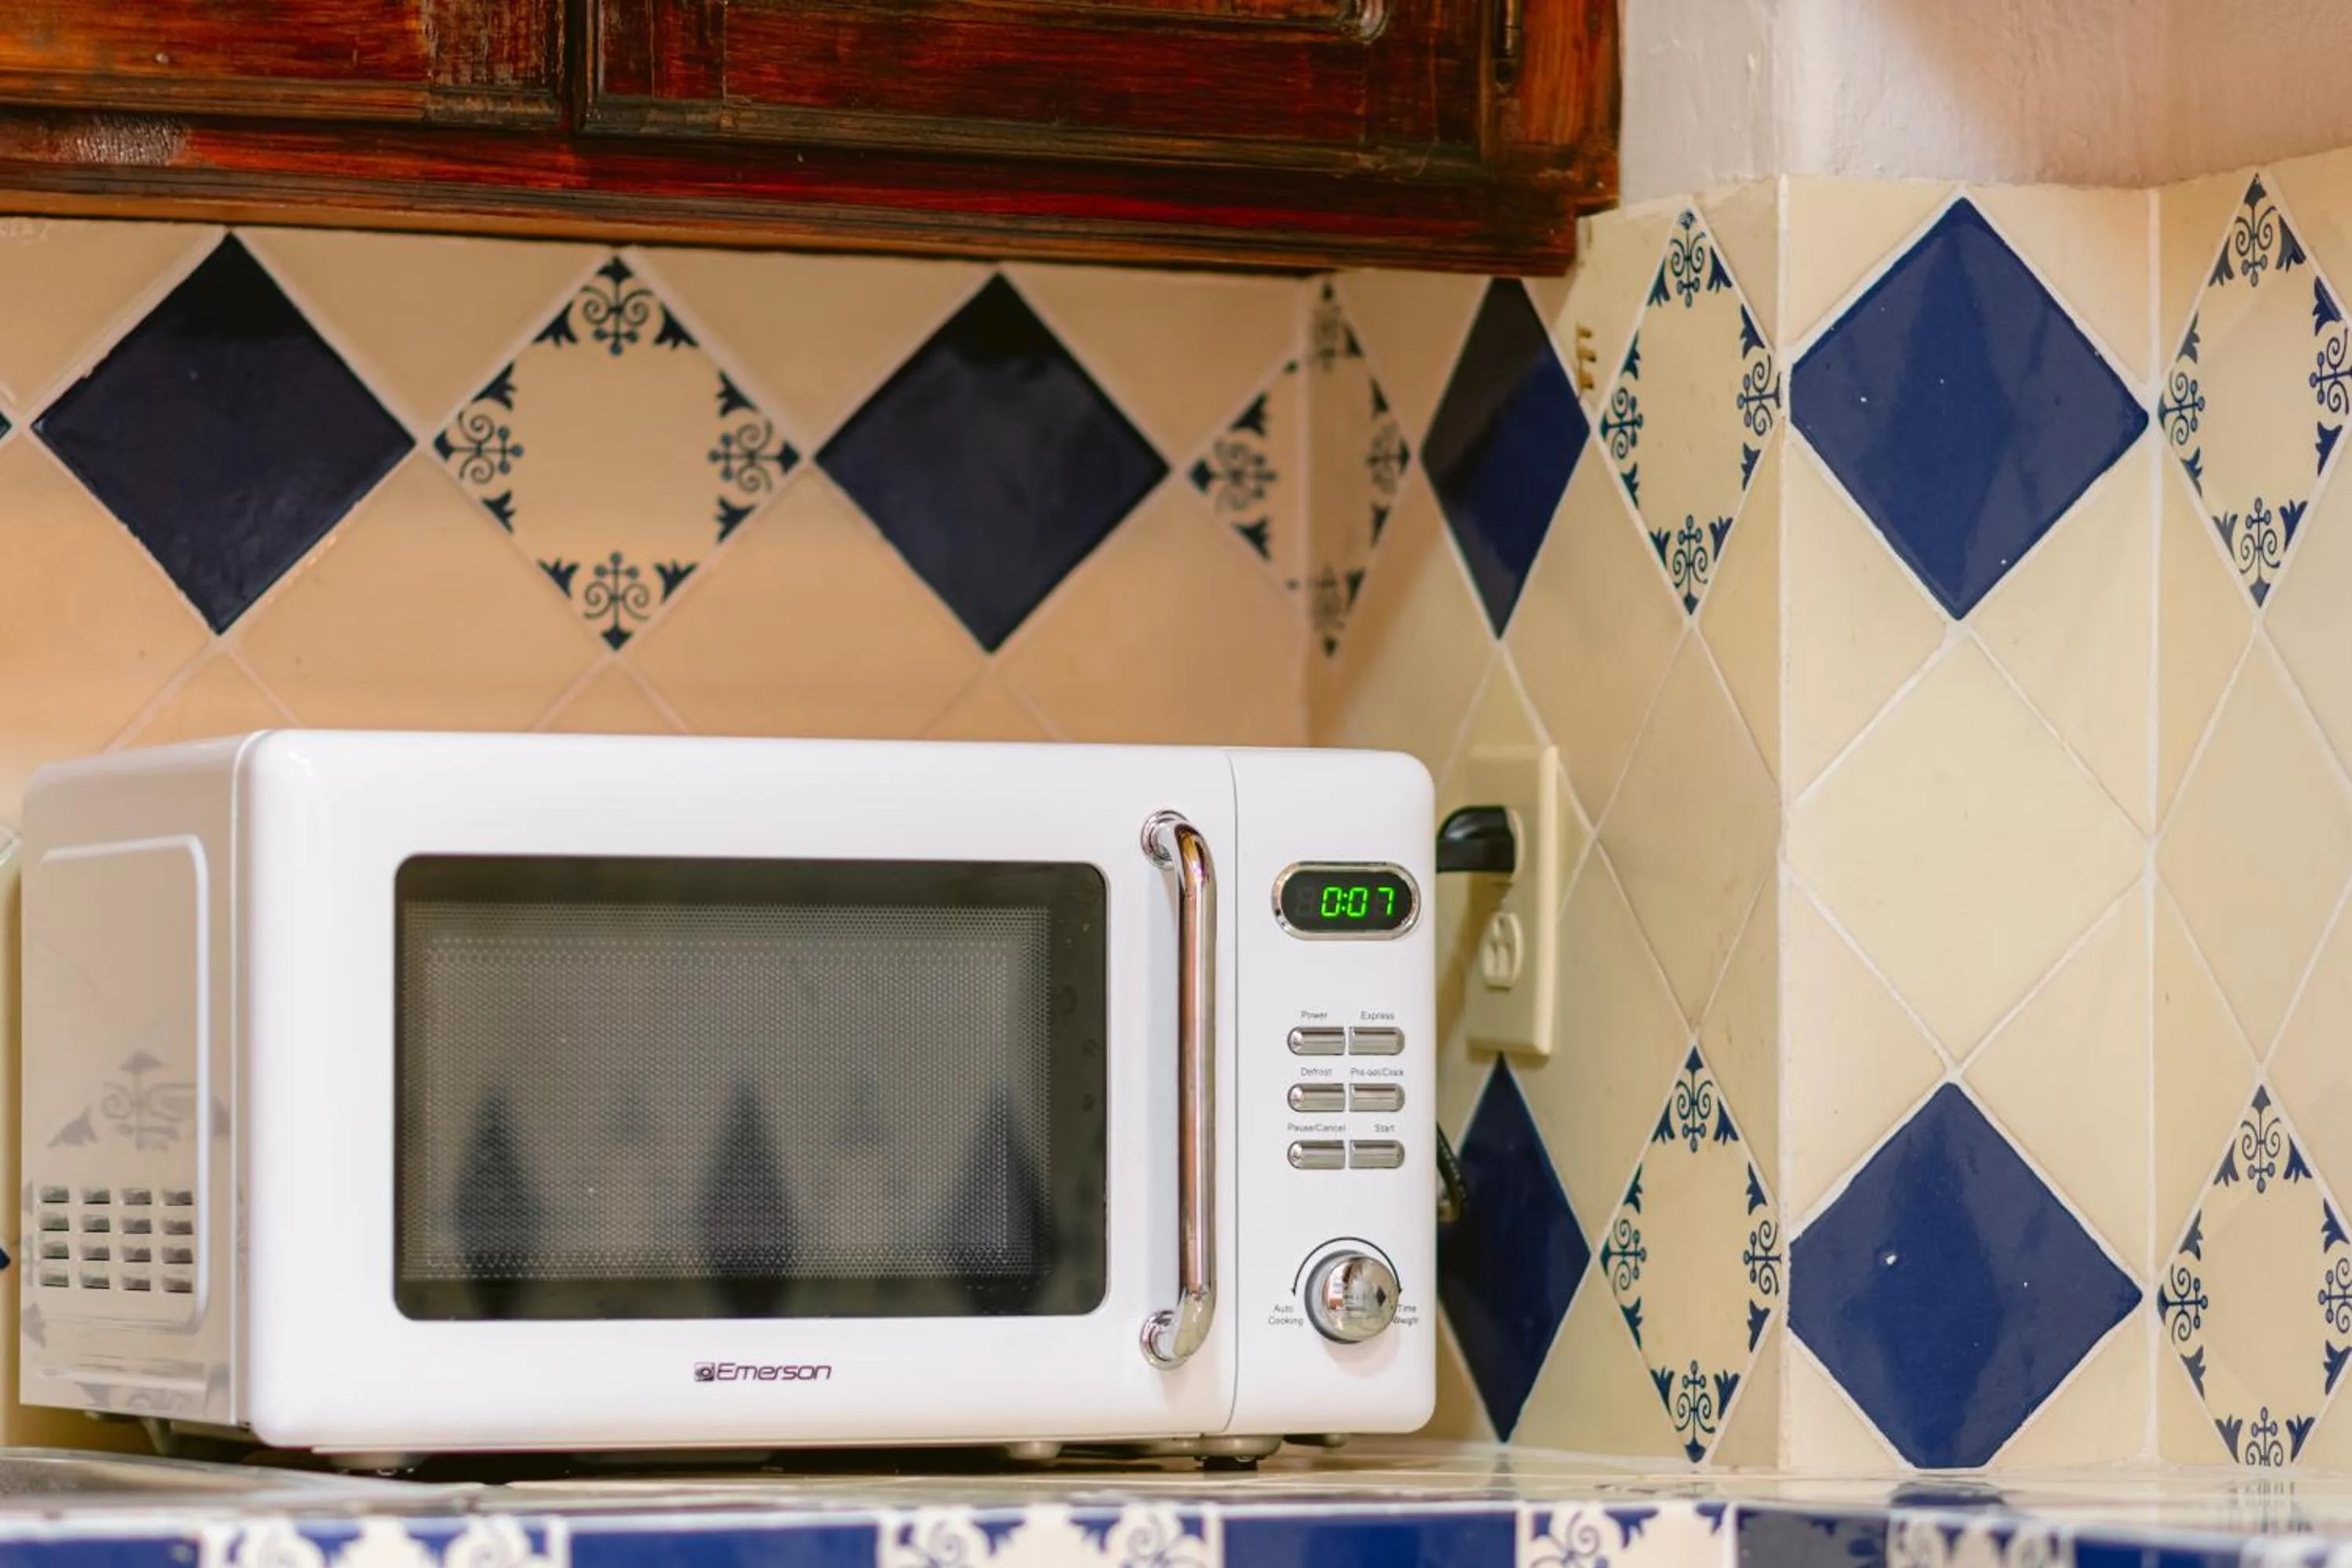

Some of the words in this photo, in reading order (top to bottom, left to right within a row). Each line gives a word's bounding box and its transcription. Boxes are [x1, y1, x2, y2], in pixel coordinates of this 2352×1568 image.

[1320, 887, 1394, 916] 0:07
[1301, 1010, 1327, 1019] Power
[1360, 1010, 1395, 1021] Express
[1300, 1067, 1332, 1077] Defrost
[1374, 1123, 1395, 1133] Start
[1273, 1304, 1294, 1312] Auto
[1268, 1316, 1303, 1327] Cooking
[717, 1362, 833, 1381] Emerson
